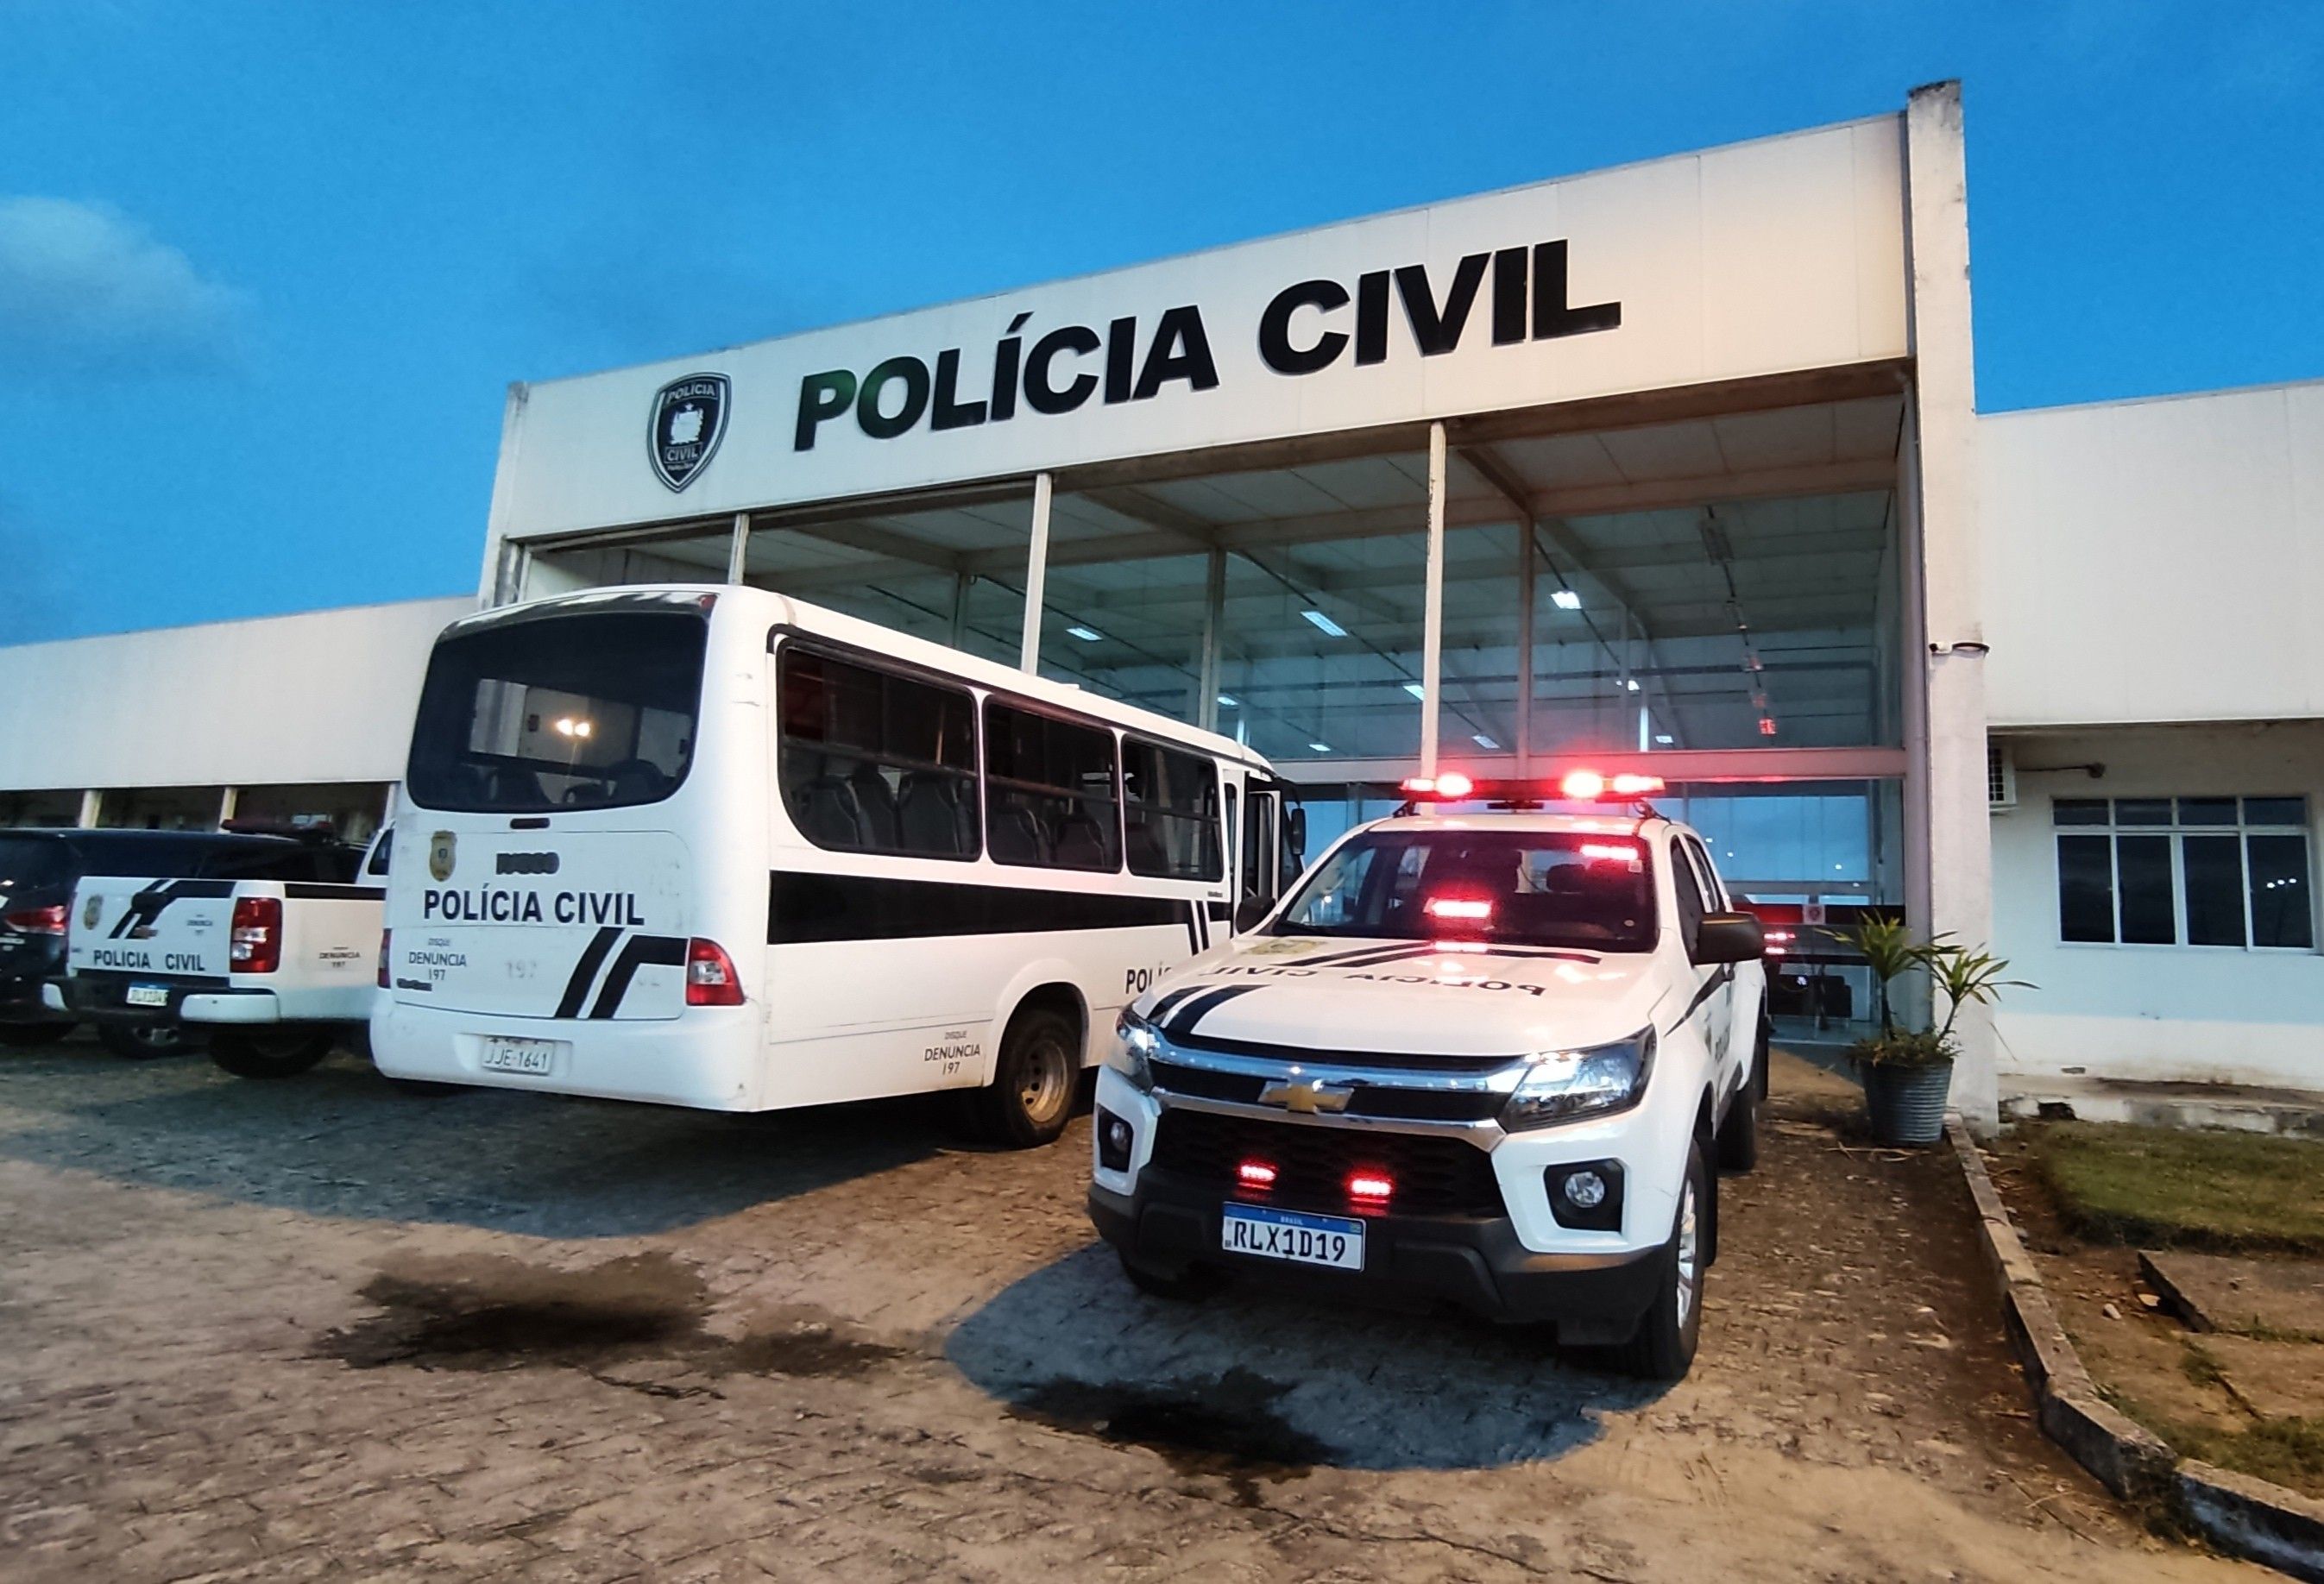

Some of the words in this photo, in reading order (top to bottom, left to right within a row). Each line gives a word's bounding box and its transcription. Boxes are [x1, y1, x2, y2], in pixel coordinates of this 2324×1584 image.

[794, 305, 1220, 451] POLÍCIA
[1257, 238, 1622, 376] CIVIL
[666, 446, 698, 462] CIVIL
[424, 883, 544, 922] POLÍCIA
[554, 891, 645, 926] CIVIL
[93, 950, 151, 969] POLICIA
[165, 953, 205, 971] CIVIL
[408, 951, 467, 967] DENUNCIA
[428, 968, 446, 981] 197
[1125, 961, 1172, 994] POL
[924, 1044, 980, 1062] DENUNCIA
[942, 1061, 960, 1075] 197
[1233, 1221, 1346, 1261] RLX1D19
